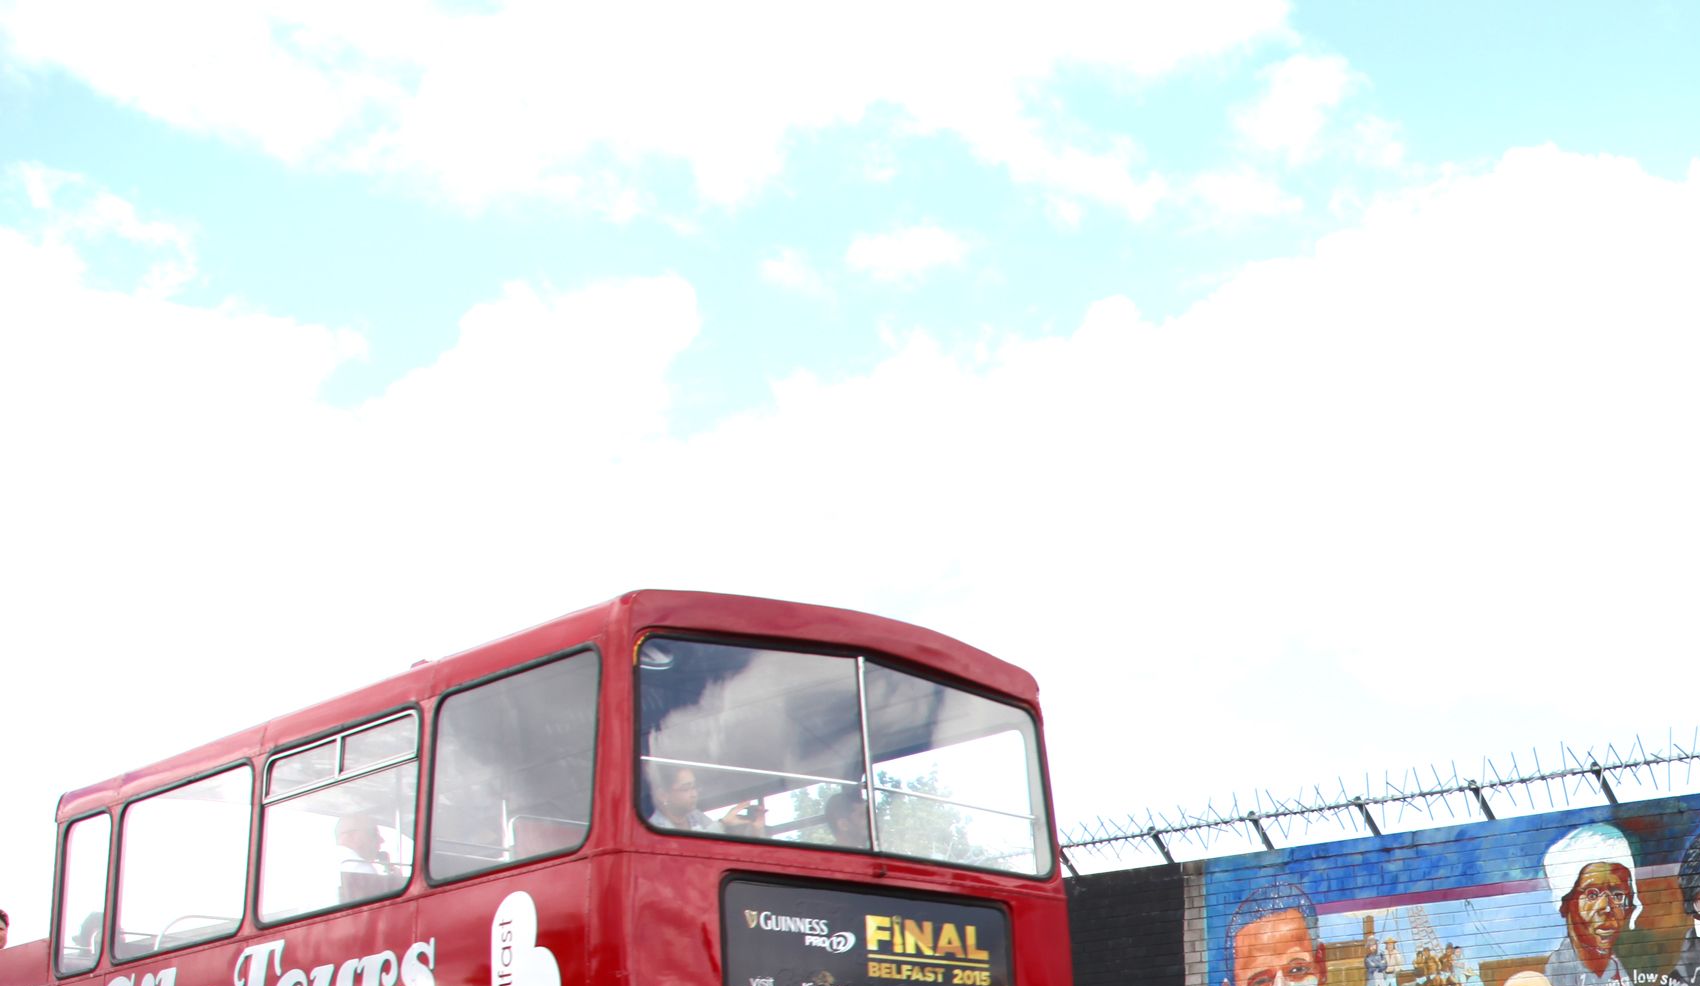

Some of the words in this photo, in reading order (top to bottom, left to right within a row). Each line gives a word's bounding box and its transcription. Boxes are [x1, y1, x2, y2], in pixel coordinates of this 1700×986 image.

[760, 912, 828, 935] GUINNESS
[865, 915, 989, 960] FINAL
[868, 962, 945, 982] BELFAST
[952, 969, 990, 986] 2015
[1634, 969, 1657, 984] low
